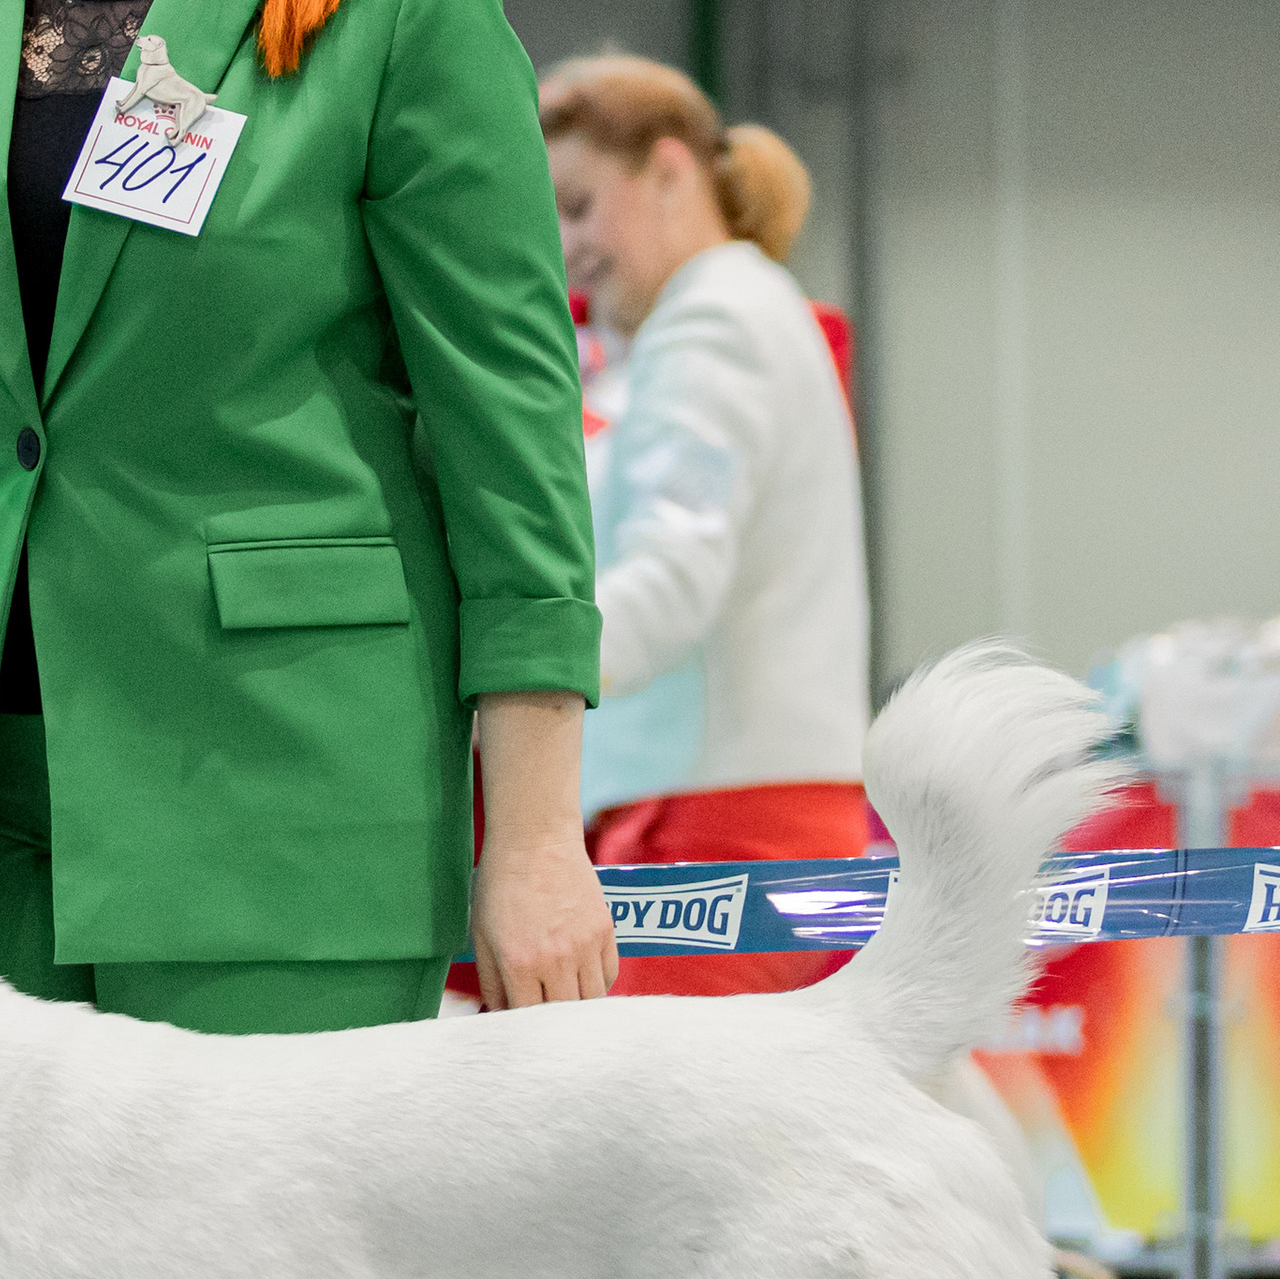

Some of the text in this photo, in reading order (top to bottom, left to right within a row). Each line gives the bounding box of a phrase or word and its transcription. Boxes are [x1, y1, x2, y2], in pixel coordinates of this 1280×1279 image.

[114, 112, 213, 150] ROYAL CNIN
[94, 133, 207, 204] 401
[657, 893, 734, 936] DOG
[1034, 888, 1096, 927] OG
